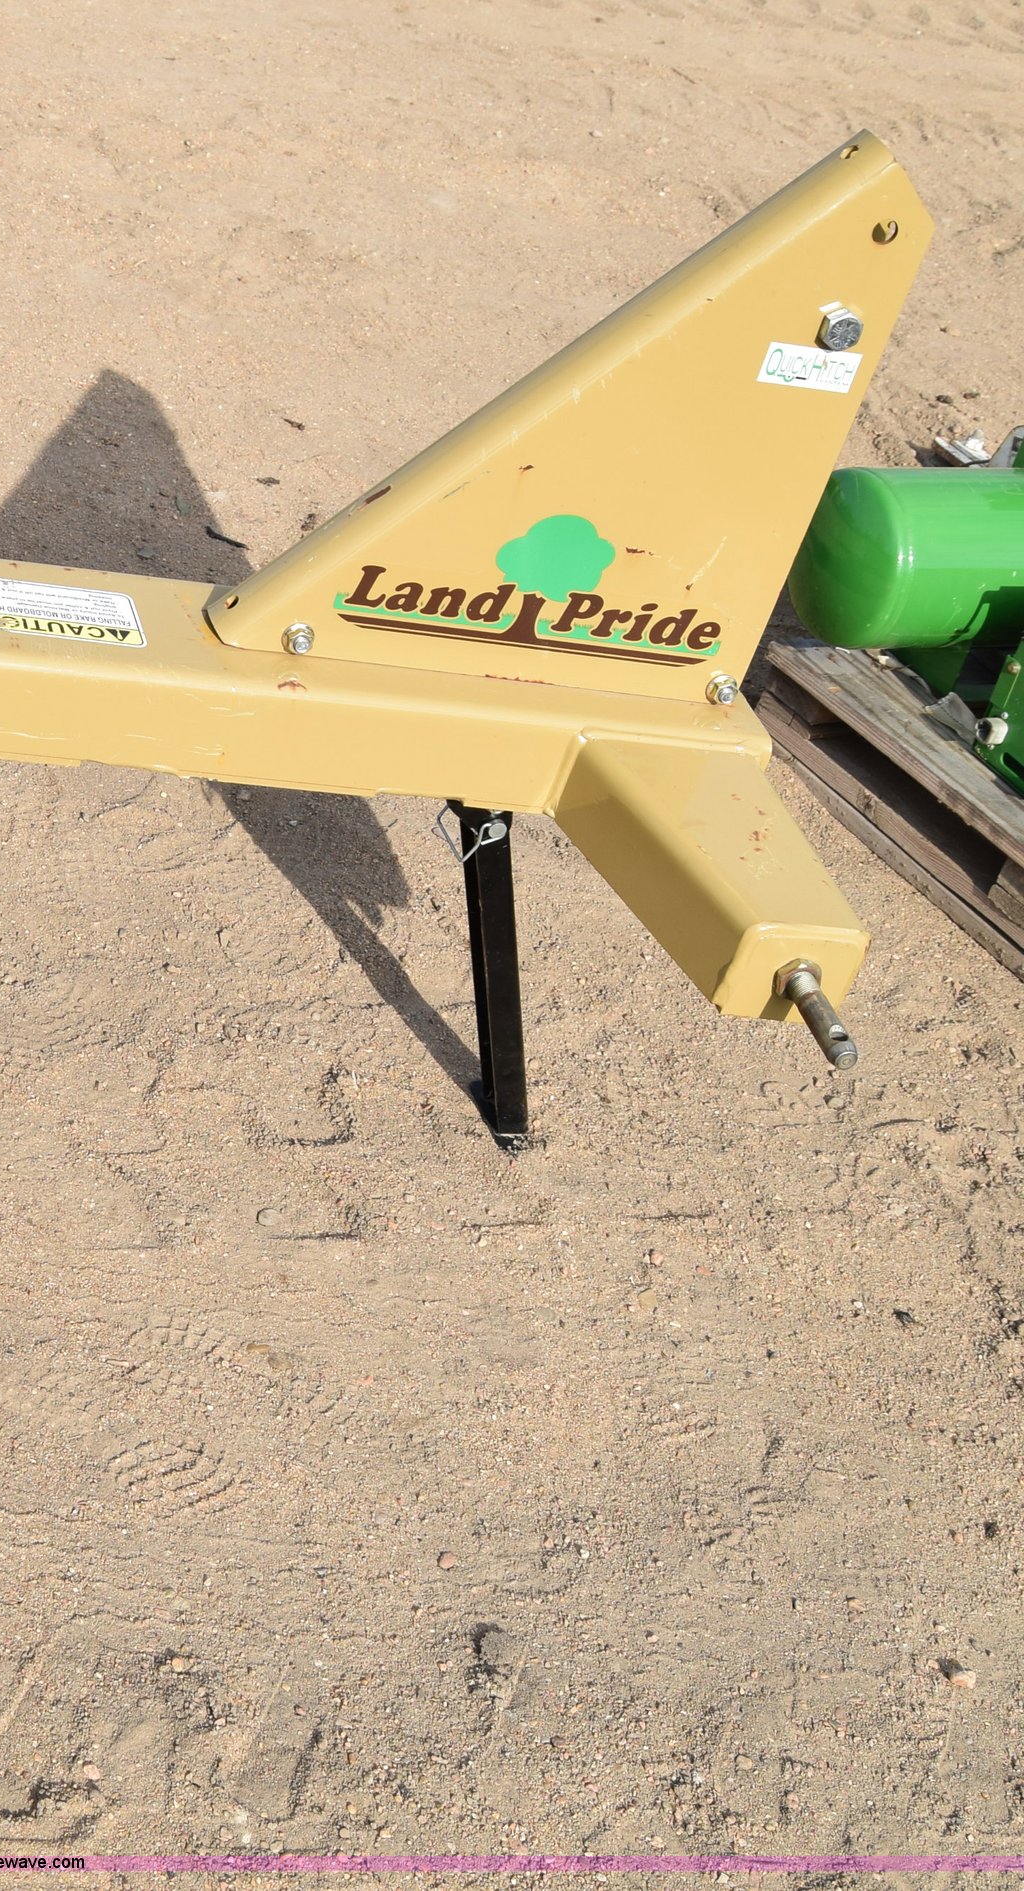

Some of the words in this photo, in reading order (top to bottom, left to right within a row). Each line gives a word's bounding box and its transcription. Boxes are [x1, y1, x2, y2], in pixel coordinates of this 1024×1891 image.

[7, 605, 59, 618] MOLDBOARD
[344, 565, 518, 623] Land
[551, 592, 722, 651] Pride
[60, 612, 72, 620] OR
[76, 614, 97, 623] RAKE
[97, 617, 131, 627] FALLING
